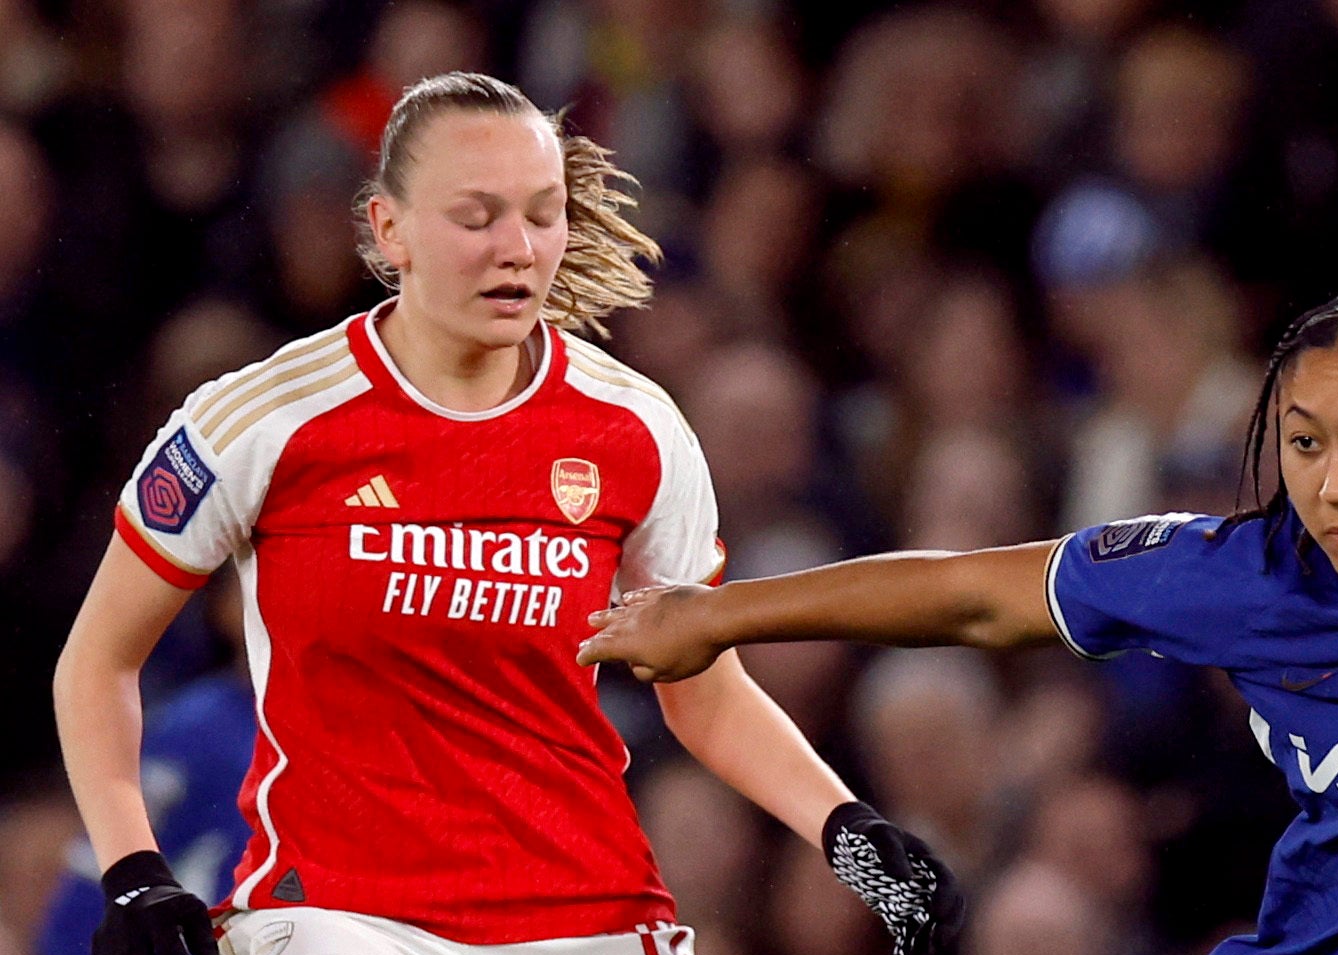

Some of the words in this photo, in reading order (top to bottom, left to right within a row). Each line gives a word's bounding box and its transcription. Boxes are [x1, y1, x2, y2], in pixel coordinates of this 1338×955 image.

[169, 441, 204, 490] WOMEN'S
[350, 522, 590, 579] Emirates
[382, 571, 442, 616] FLY
[447, 577, 562, 627] BETTER
